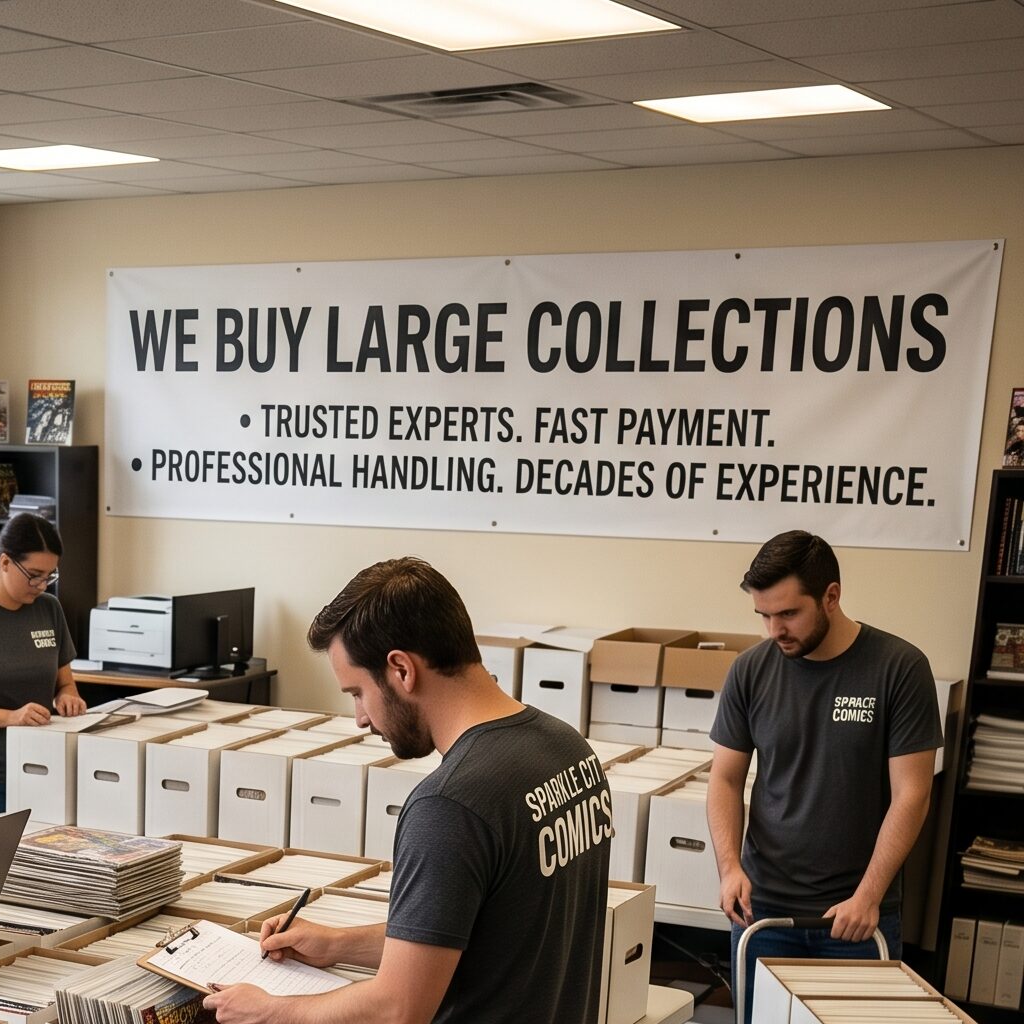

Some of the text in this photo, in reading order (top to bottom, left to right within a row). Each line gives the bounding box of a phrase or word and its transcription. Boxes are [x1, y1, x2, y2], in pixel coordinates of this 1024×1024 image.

[129, 292, 949, 374] WE BUY LARGE COLLECTIONS
[260, 404, 775, 448] TRUSTED EXPERTS. FAST PAYMENT.
[152, 448, 936, 507] PROFESSIONAL HANDLING. DECADES OF EXPERIENCE.
[525, 754, 605, 822] SPARKLE CIT
[538, 789, 612, 877] COMICS
